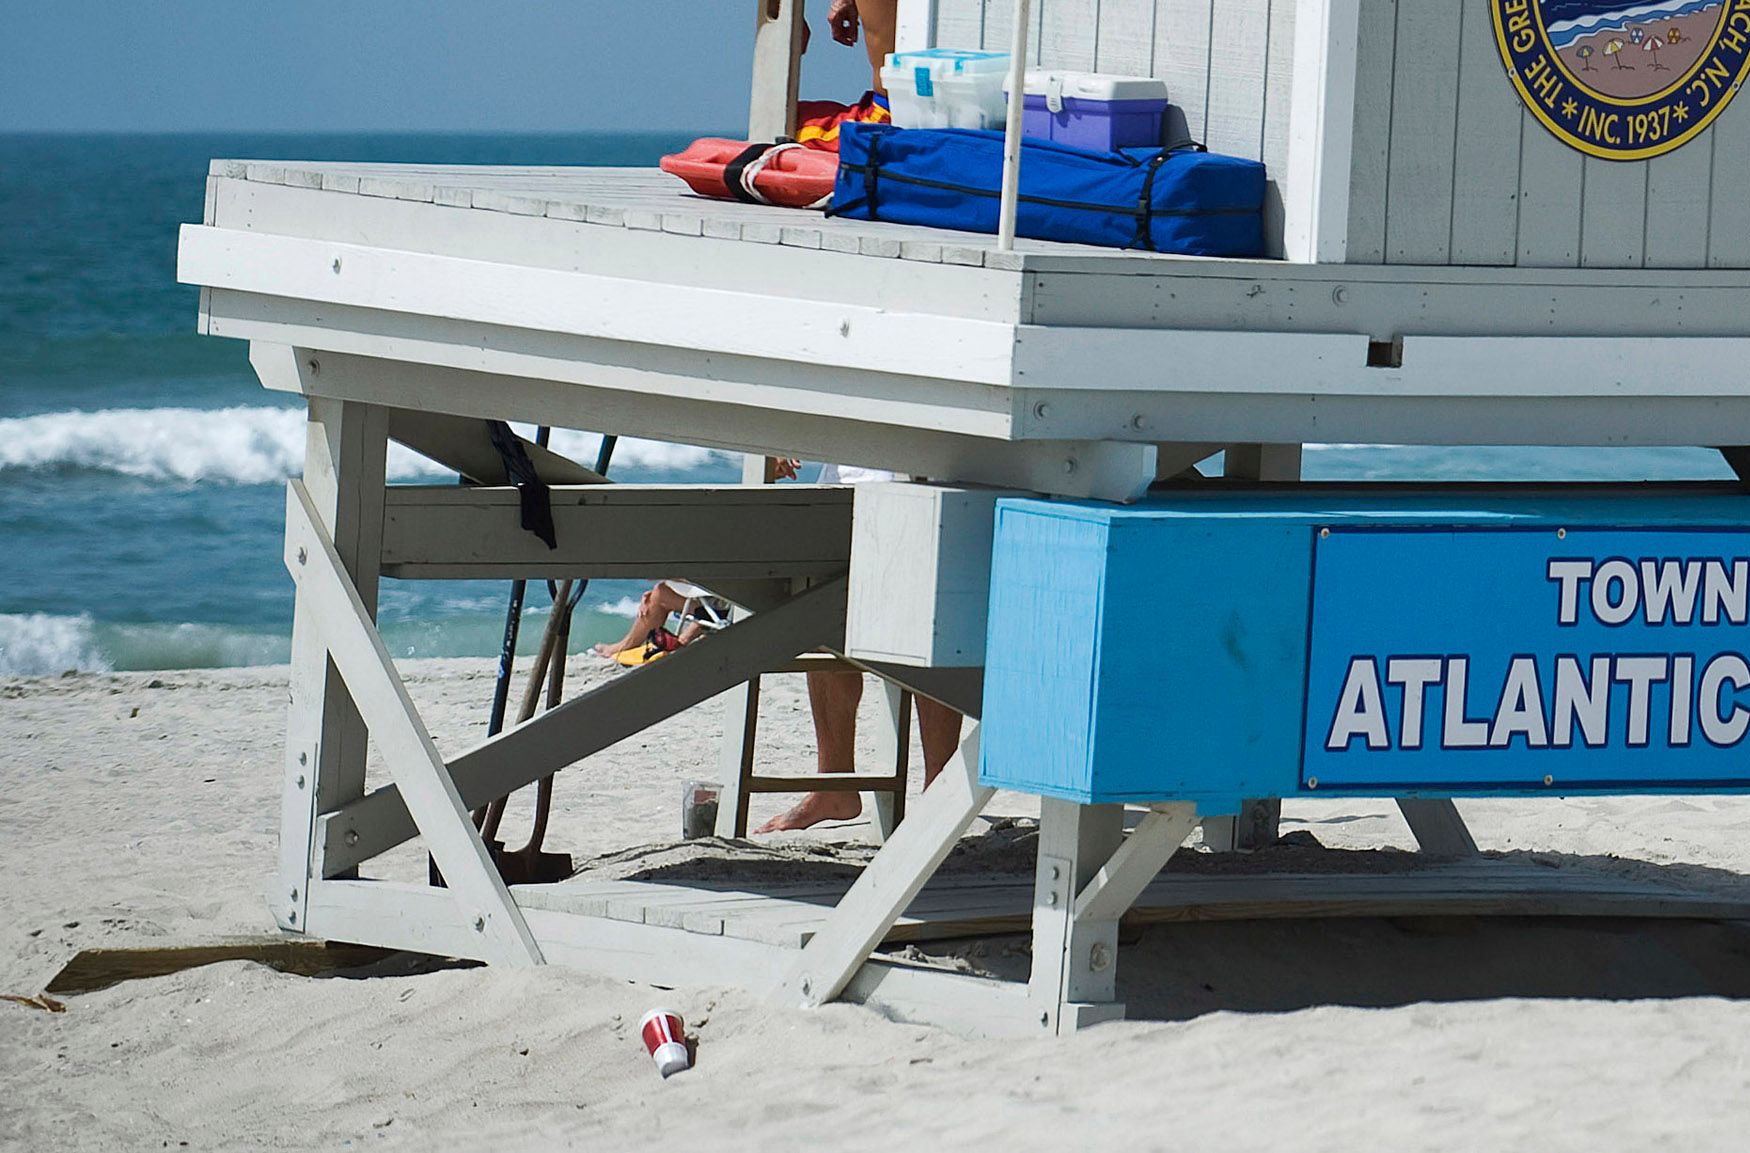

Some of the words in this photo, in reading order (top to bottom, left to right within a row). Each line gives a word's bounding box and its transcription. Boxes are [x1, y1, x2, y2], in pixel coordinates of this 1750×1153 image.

[1524, 54, 1563, 108] THE
[1686, 56, 1730, 108] N.C.
[1577, 105, 1621, 144] INC.
[1627, 105, 1671, 144] 1937
[1548, 559, 1749, 624] TOWN
